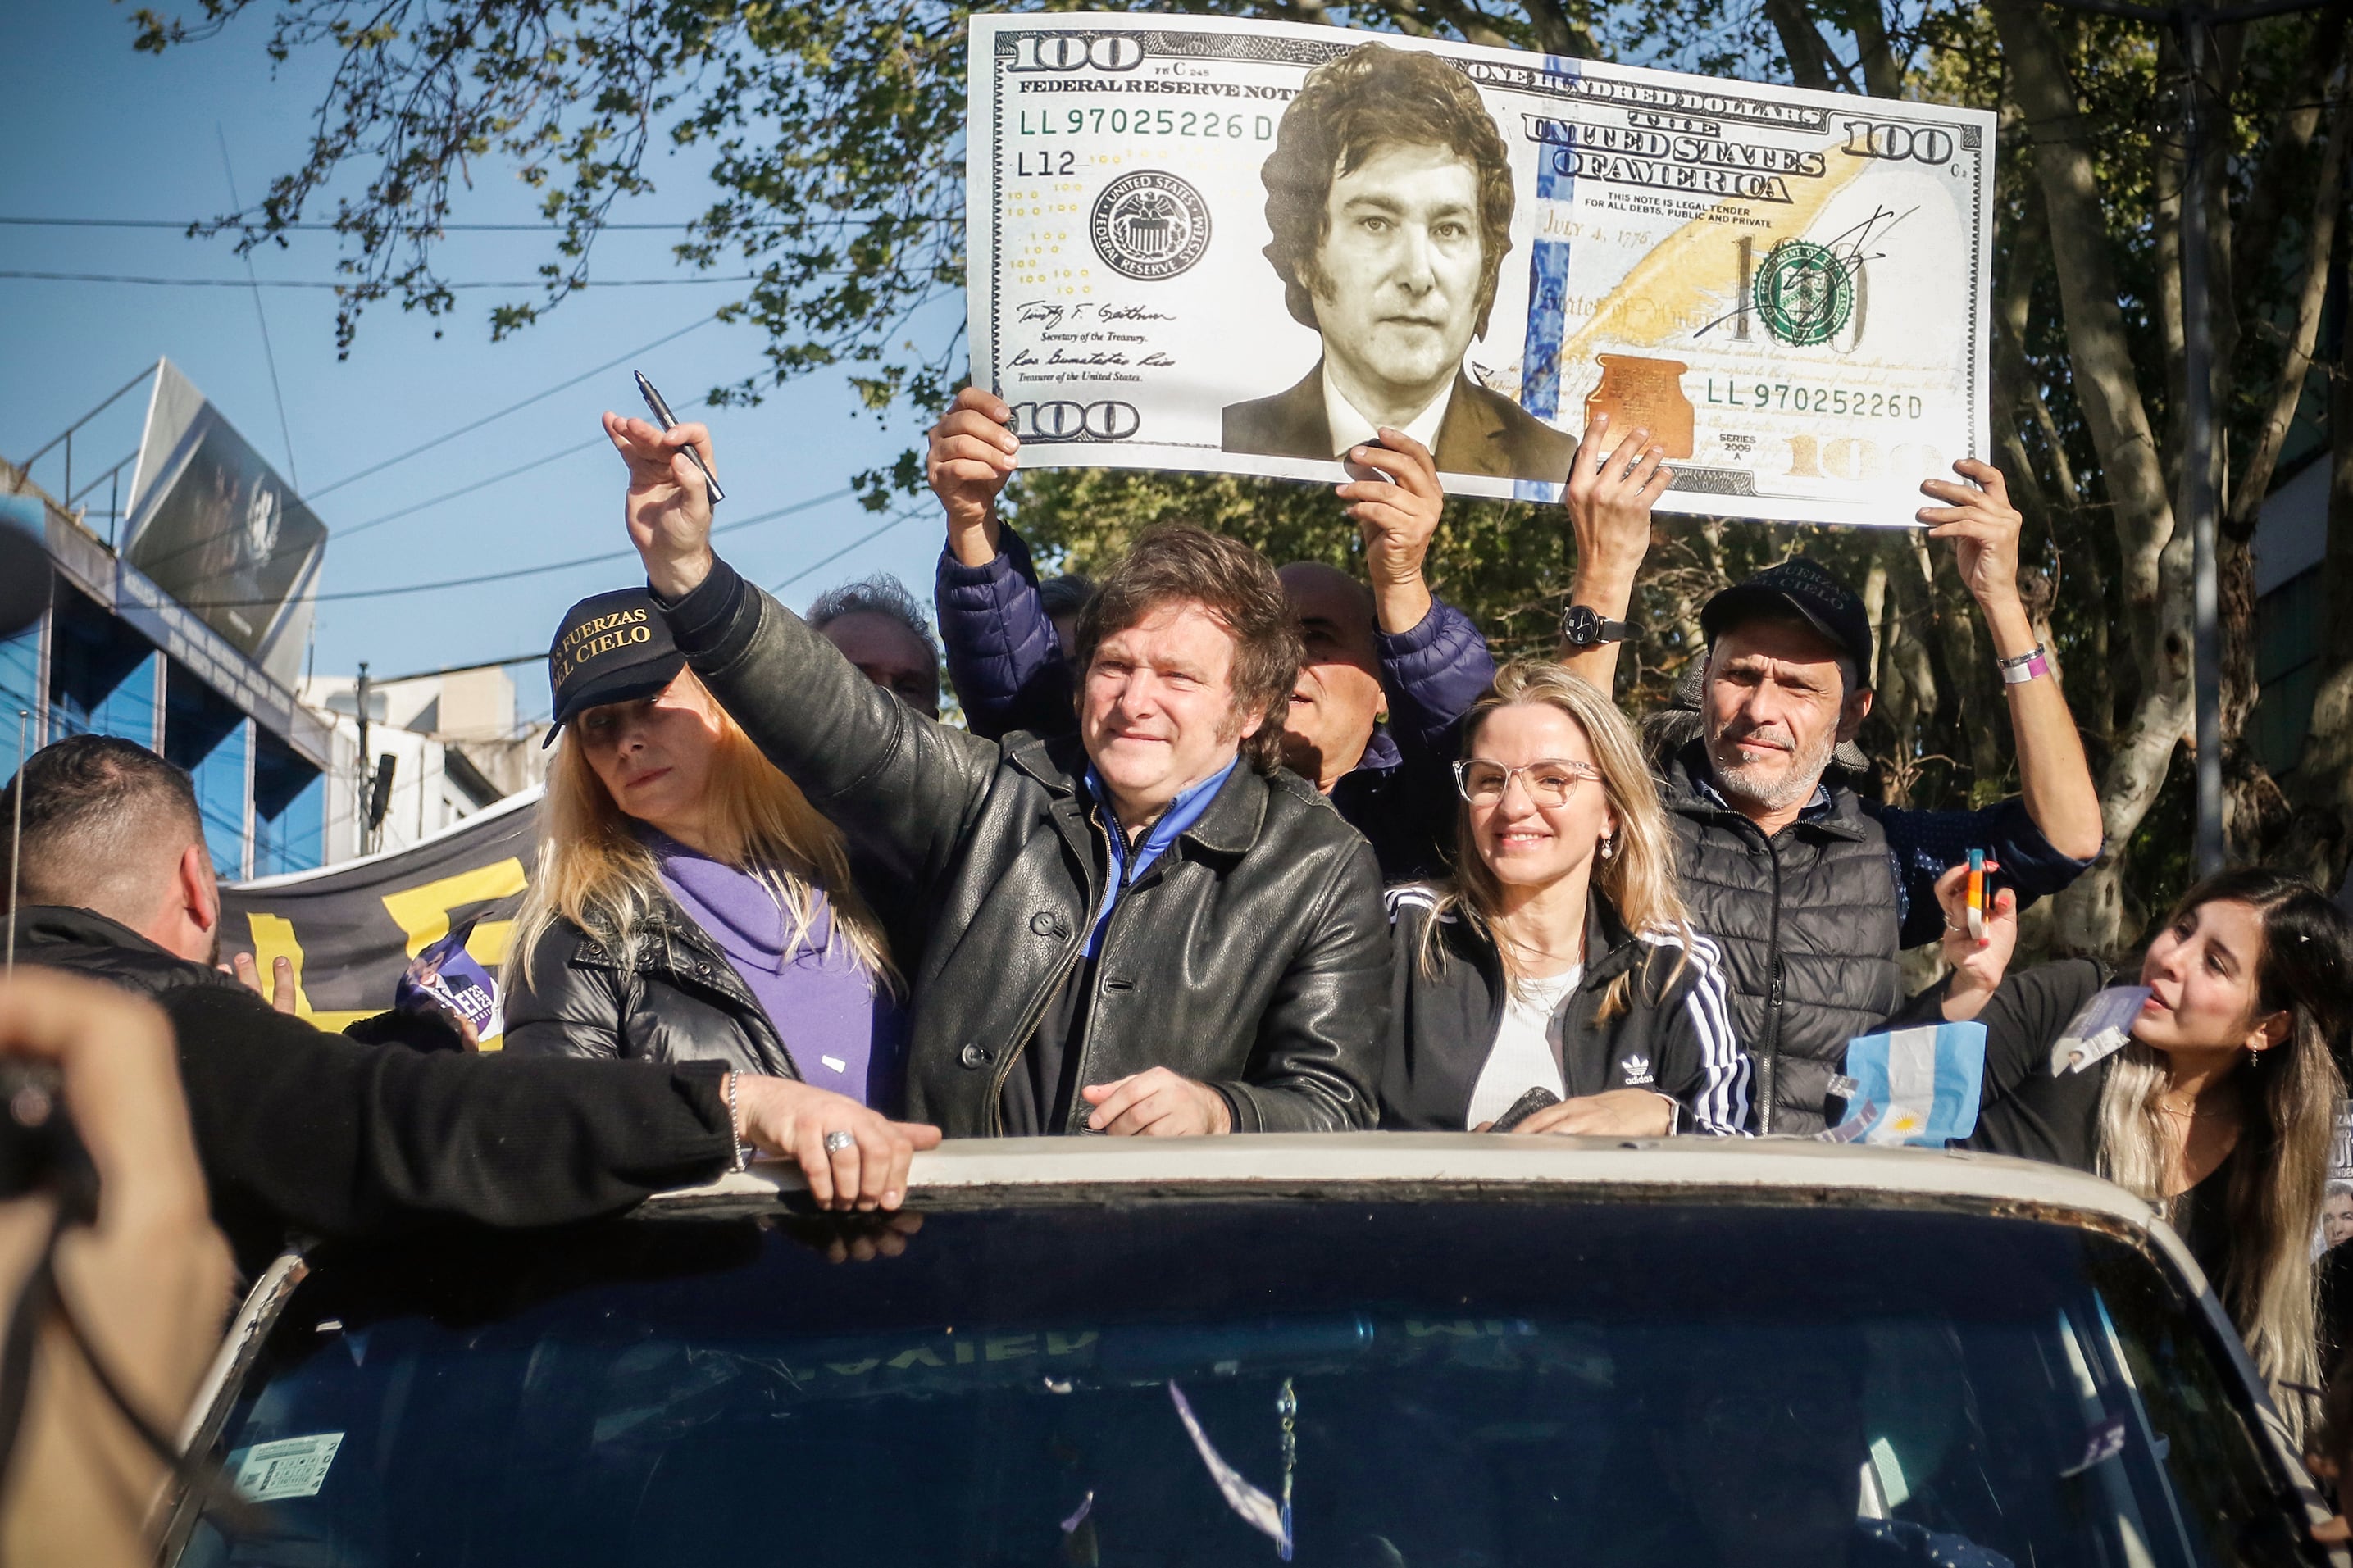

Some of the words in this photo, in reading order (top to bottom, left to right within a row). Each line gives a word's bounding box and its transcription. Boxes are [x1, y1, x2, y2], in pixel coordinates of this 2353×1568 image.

[1007, 36, 1144, 71] 100
[1019, 80, 1128, 93] FEDERAL
[1129, 80, 1240, 98] RESERVE
[1467, 63, 1529, 84] ONE
[1532, 71, 1677, 108] HUNDRED
[1679, 93, 1822, 125] DOLLARS
[1627, 110, 1721, 137] THE
[1521, 112, 1671, 158] UNITED
[1673, 134, 1826, 178] STATES
[1841, 121, 1953, 165] 100
[1017, 150, 1076, 177] L12
[1552, 148, 1605, 180] OF
[1604, 156, 1794, 204] AMERICA
[1107, 176, 1151, 202] UNITED
[1156, 177, 1195, 205] STATES
[1608, 192, 1632, 202] THIS
[1633, 196, 1661, 206] NOTE
[1677, 200, 1708, 212] LEGAL
[1710, 204, 1750, 216] TENDER
[1585, 198, 1604, 207] FOR
[1607, 202, 1627, 211] ALL
[1629, 204, 1664, 216] DEBTS,
[1668, 208, 1705, 220] PUBLIC
[1708, 213, 1730, 224] AND
[1732, 216, 1772, 228] PRIVATE
[1095, 212, 1119, 262] FEDERAL
[1121, 258, 1177, 275] RESERVE
[1179, 216, 1204, 263] SYSTEM
[1040, 332, 1077, 343] Secretary
[1080, 332, 1090, 343] of
[1090, 333, 1104, 341] the
[1018, 372, 1054, 382] Treasurer
[1055, 373, 1067, 384] of
[1067, 372, 1079, 381] the
[1082, 371, 1111, 382] United
[1012, 400, 1140, 440] 100
[1719, 434, 1756, 444] SERIES
[1724, 443, 1752, 452] 2009
[562, 608, 648, 653] FUERZAS
[576, 625, 651, 664] CIELO
[1625, 1074, 1654, 1085] adidas
